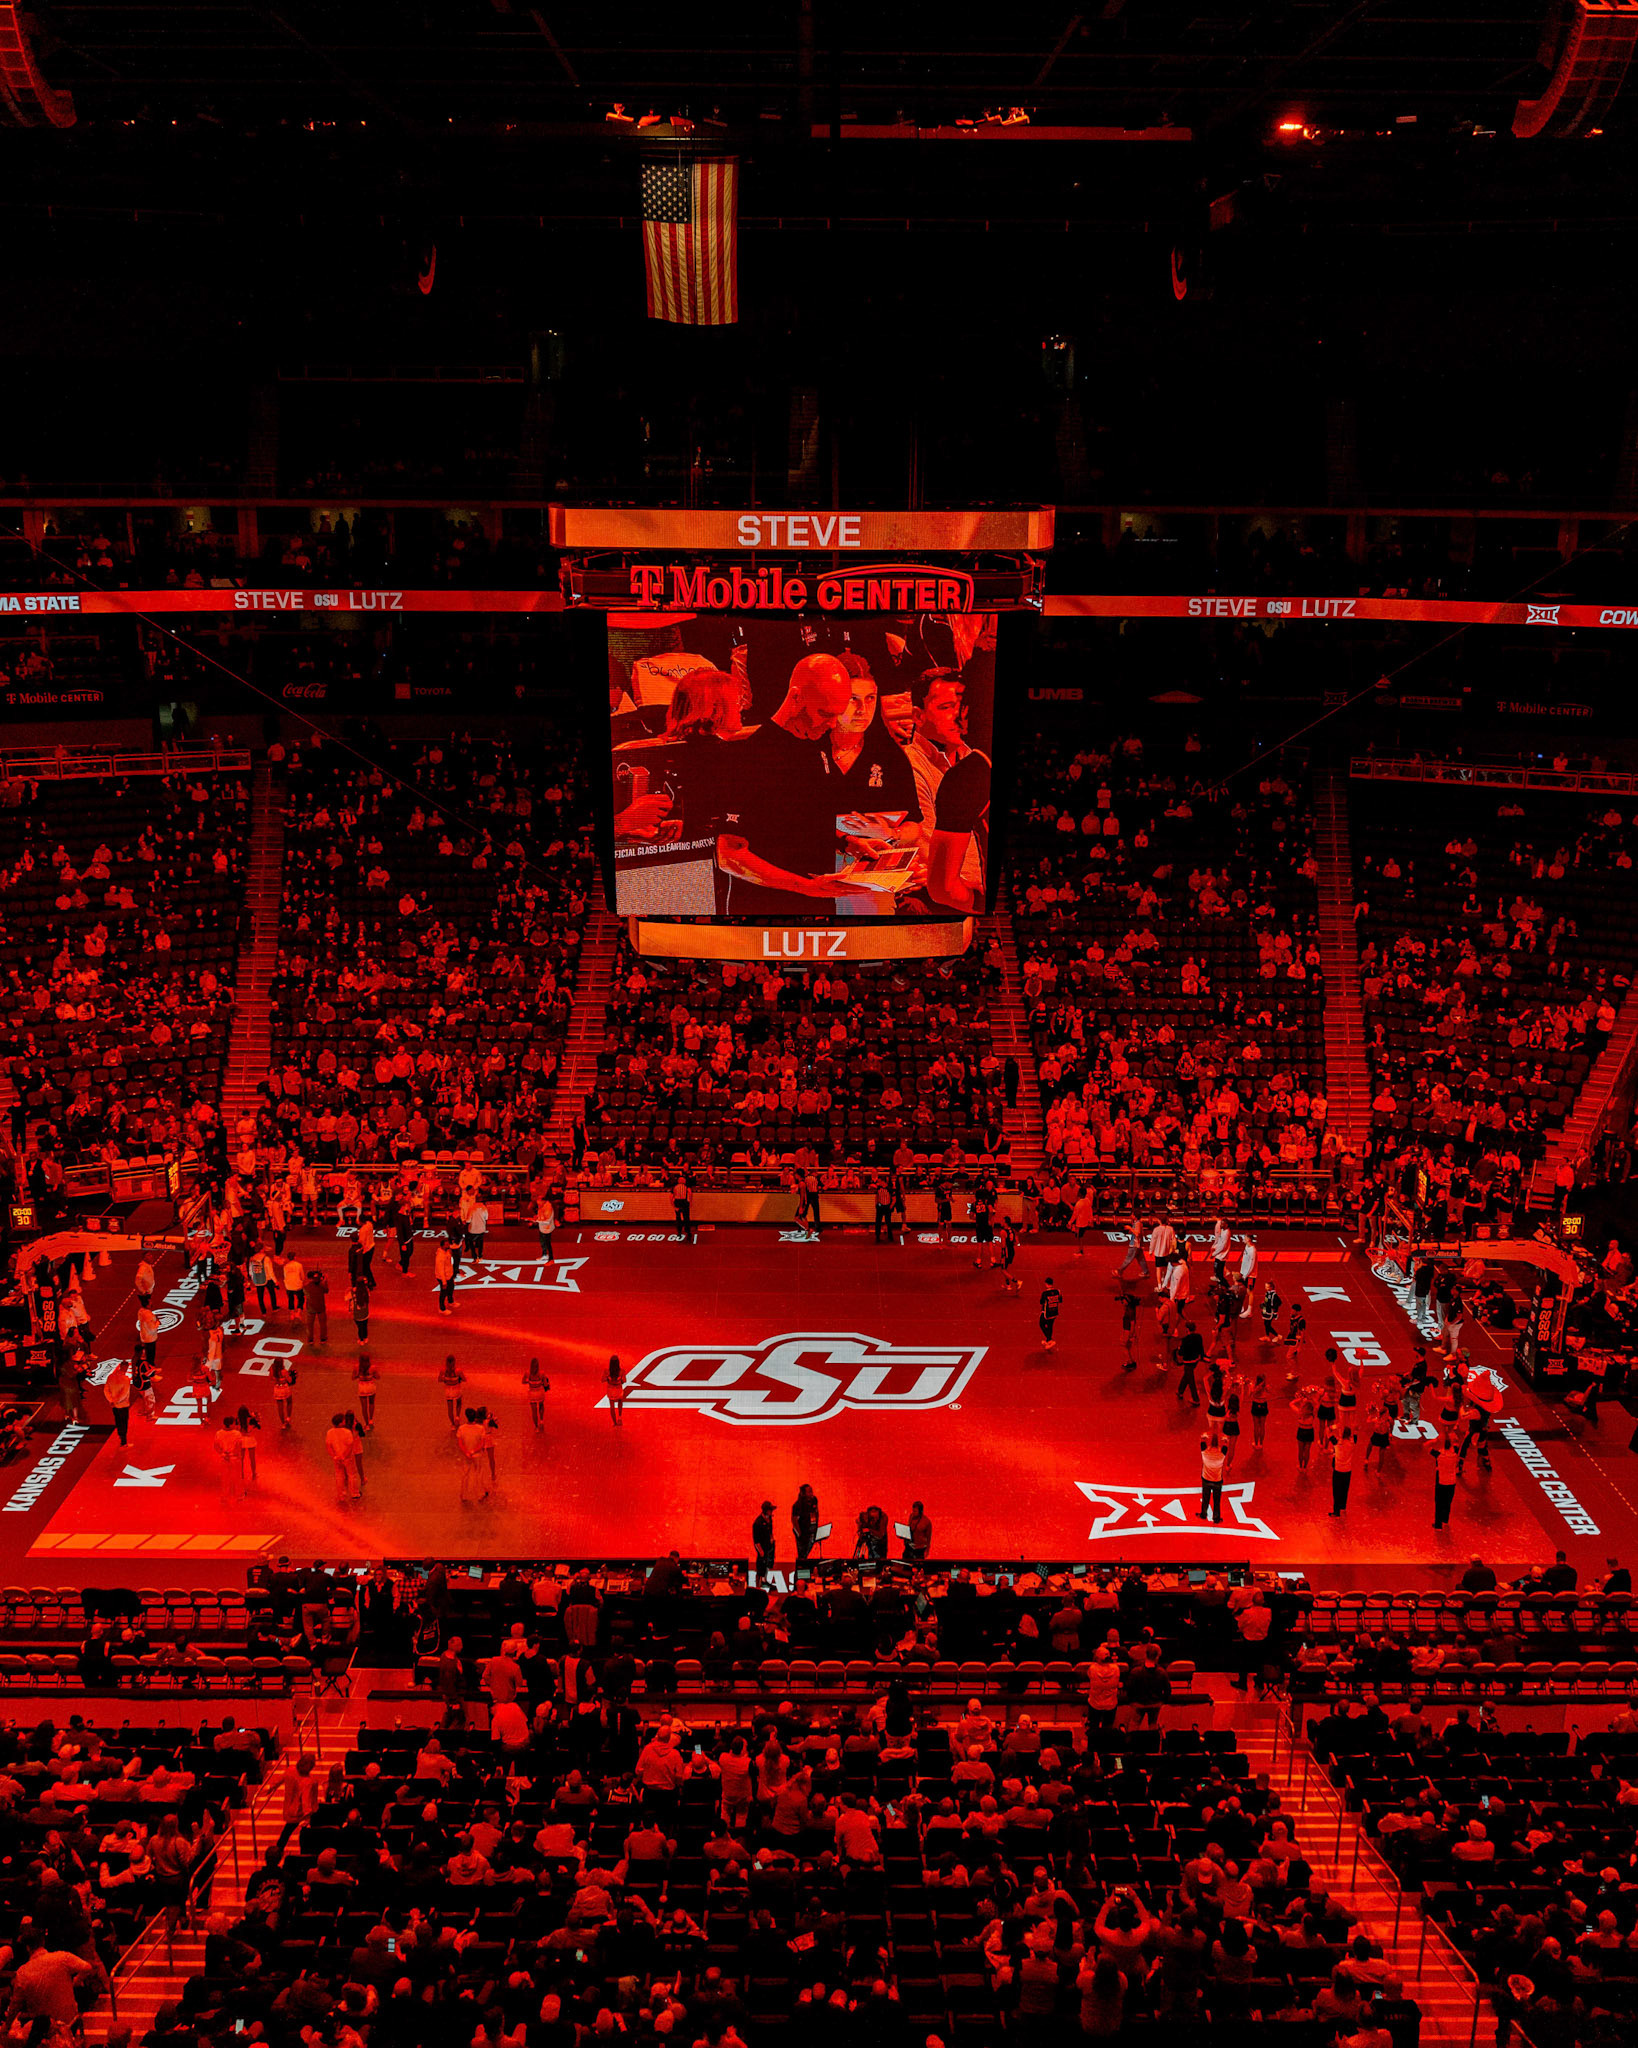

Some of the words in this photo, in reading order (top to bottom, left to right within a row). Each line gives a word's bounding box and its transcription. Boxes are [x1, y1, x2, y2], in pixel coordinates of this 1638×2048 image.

[738, 515, 861, 546] STEVE
[670, 566, 807, 610] Mobile
[817, 578, 962, 611] CENTER
[24, 595, 80, 611] STATE
[234, 591, 304, 609] STEVE
[313, 594, 338, 606] OSU
[349, 592, 404, 609] LUTZ
[1188, 598, 1257, 616] STEVE
[1266, 601, 1291, 614] OSU
[1302, 599, 1356, 617] LUTZ
[19, 691, 58, 704] Mobile
[60, 692, 101, 703] CENTER
[414, 687, 453, 696] TOYOTA
[1028, 687, 1084, 701] UMB
[1509, 701, 1548, 715] Mobile
[1549, 705, 1590, 717] CENTER
[637, 845, 658, 856] GLASS
[658, 841, 691, 853] CLEANING
[763, 931, 847, 956] LUTZ
[12, 1207, 32, 1216] 20:00
[17, 1216, 30, 1225] 30
[1562, 1217, 1581, 1225] 20:00
[1565, 1225, 1578, 1234] 30
[627, 1233, 646, 1241] GO
[647, 1233, 666, 1241] GO
[950, 1235, 968, 1243] GO
[42, 1300, 54, 1311] GO
[43, 1310, 56, 1321] GO
[1539, 1310, 1552, 1320] GO
[43, 1321, 57, 1332] GO
[1538, 1320, 1551, 1331] GO
[1537, 1330, 1550, 1341] GO
[603, 1332, 987, 1426] OSU
[2, 1457, 67, 1512] KANSAS
[46, 1423, 91, 1455] CITY
[1493, 1416, 1560, 1479] T-MOBILE
[1538, 1480, 1601, 1535] CENTER
